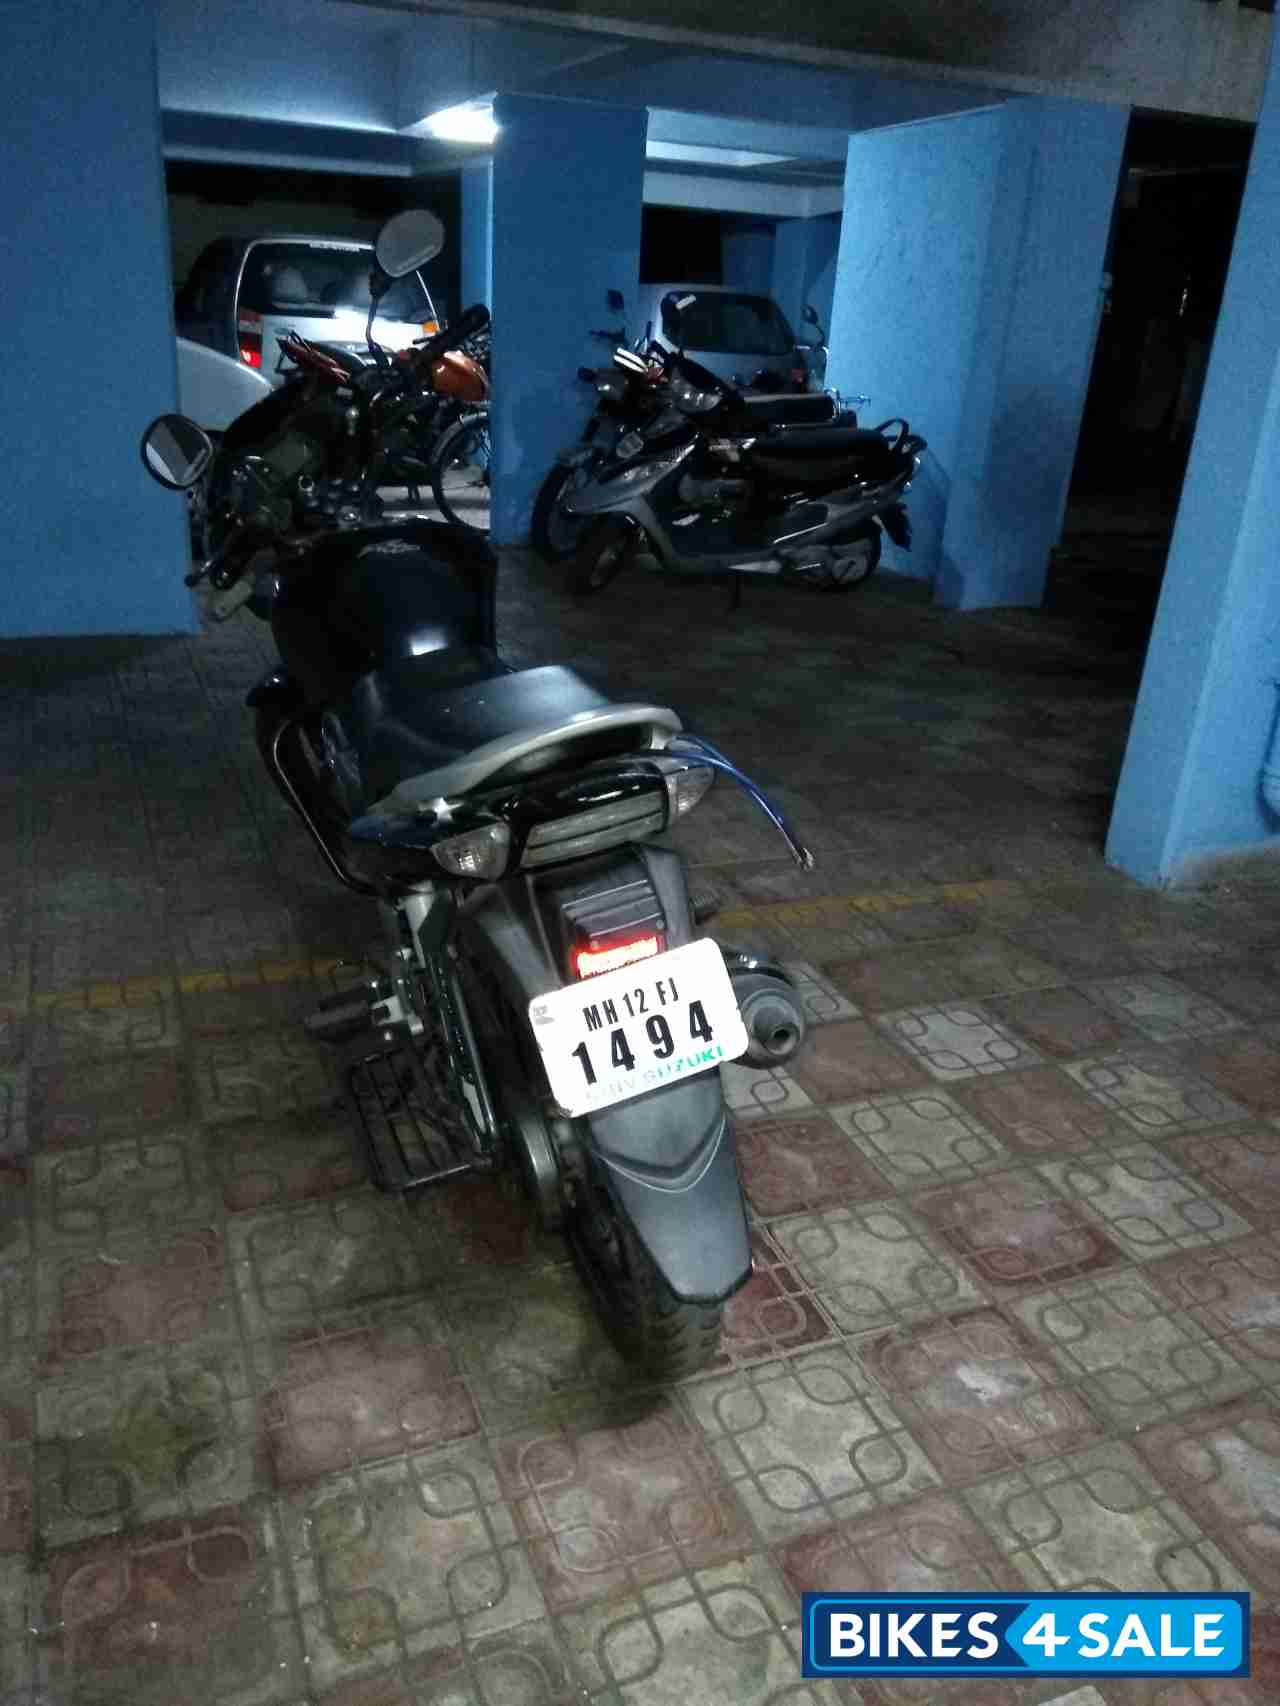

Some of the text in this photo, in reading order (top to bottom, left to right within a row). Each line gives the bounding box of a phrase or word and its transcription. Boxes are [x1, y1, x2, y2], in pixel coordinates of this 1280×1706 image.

[583, 977, 679, 1031] MH 12 FJ
[571, 999, 714, 1085] 1494
[642, 1045, 724, 1081] SUZUKI
